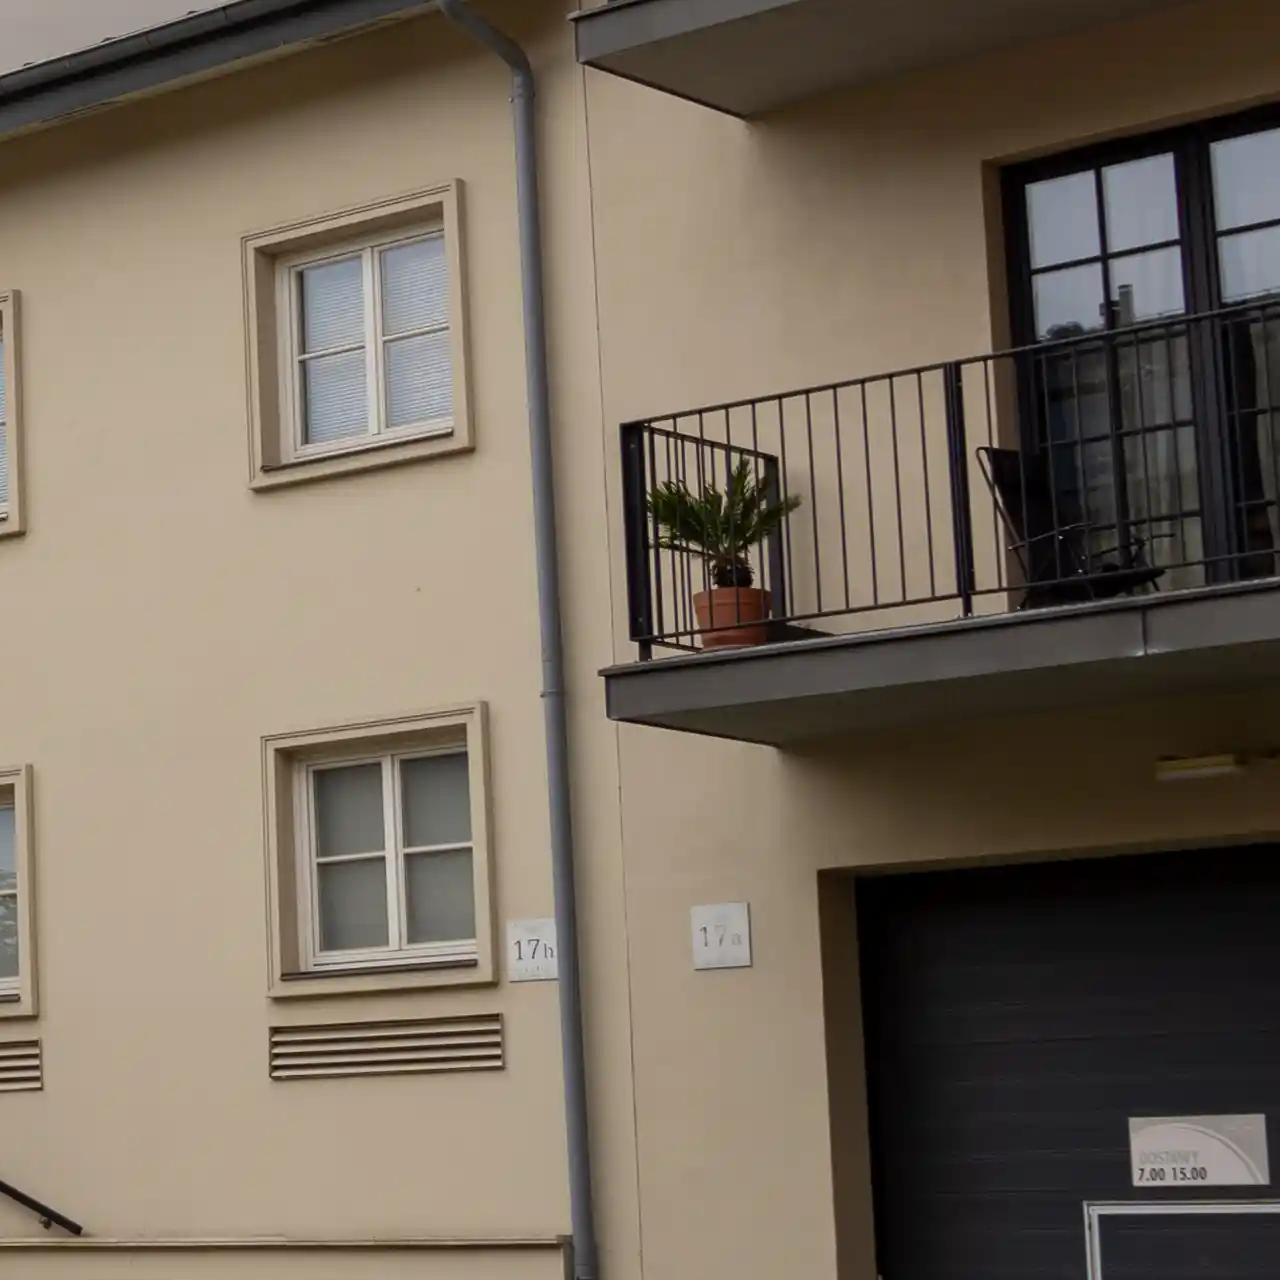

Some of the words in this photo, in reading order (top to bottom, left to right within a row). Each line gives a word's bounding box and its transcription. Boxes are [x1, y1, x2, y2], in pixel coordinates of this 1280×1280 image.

[699, 925, 743, 948] 17a
[513, 938, 555, 961] 17h
[1138, 1167, 1166, 1181] 7.00
[1171, 1166, 1207, 1181] 15.00
